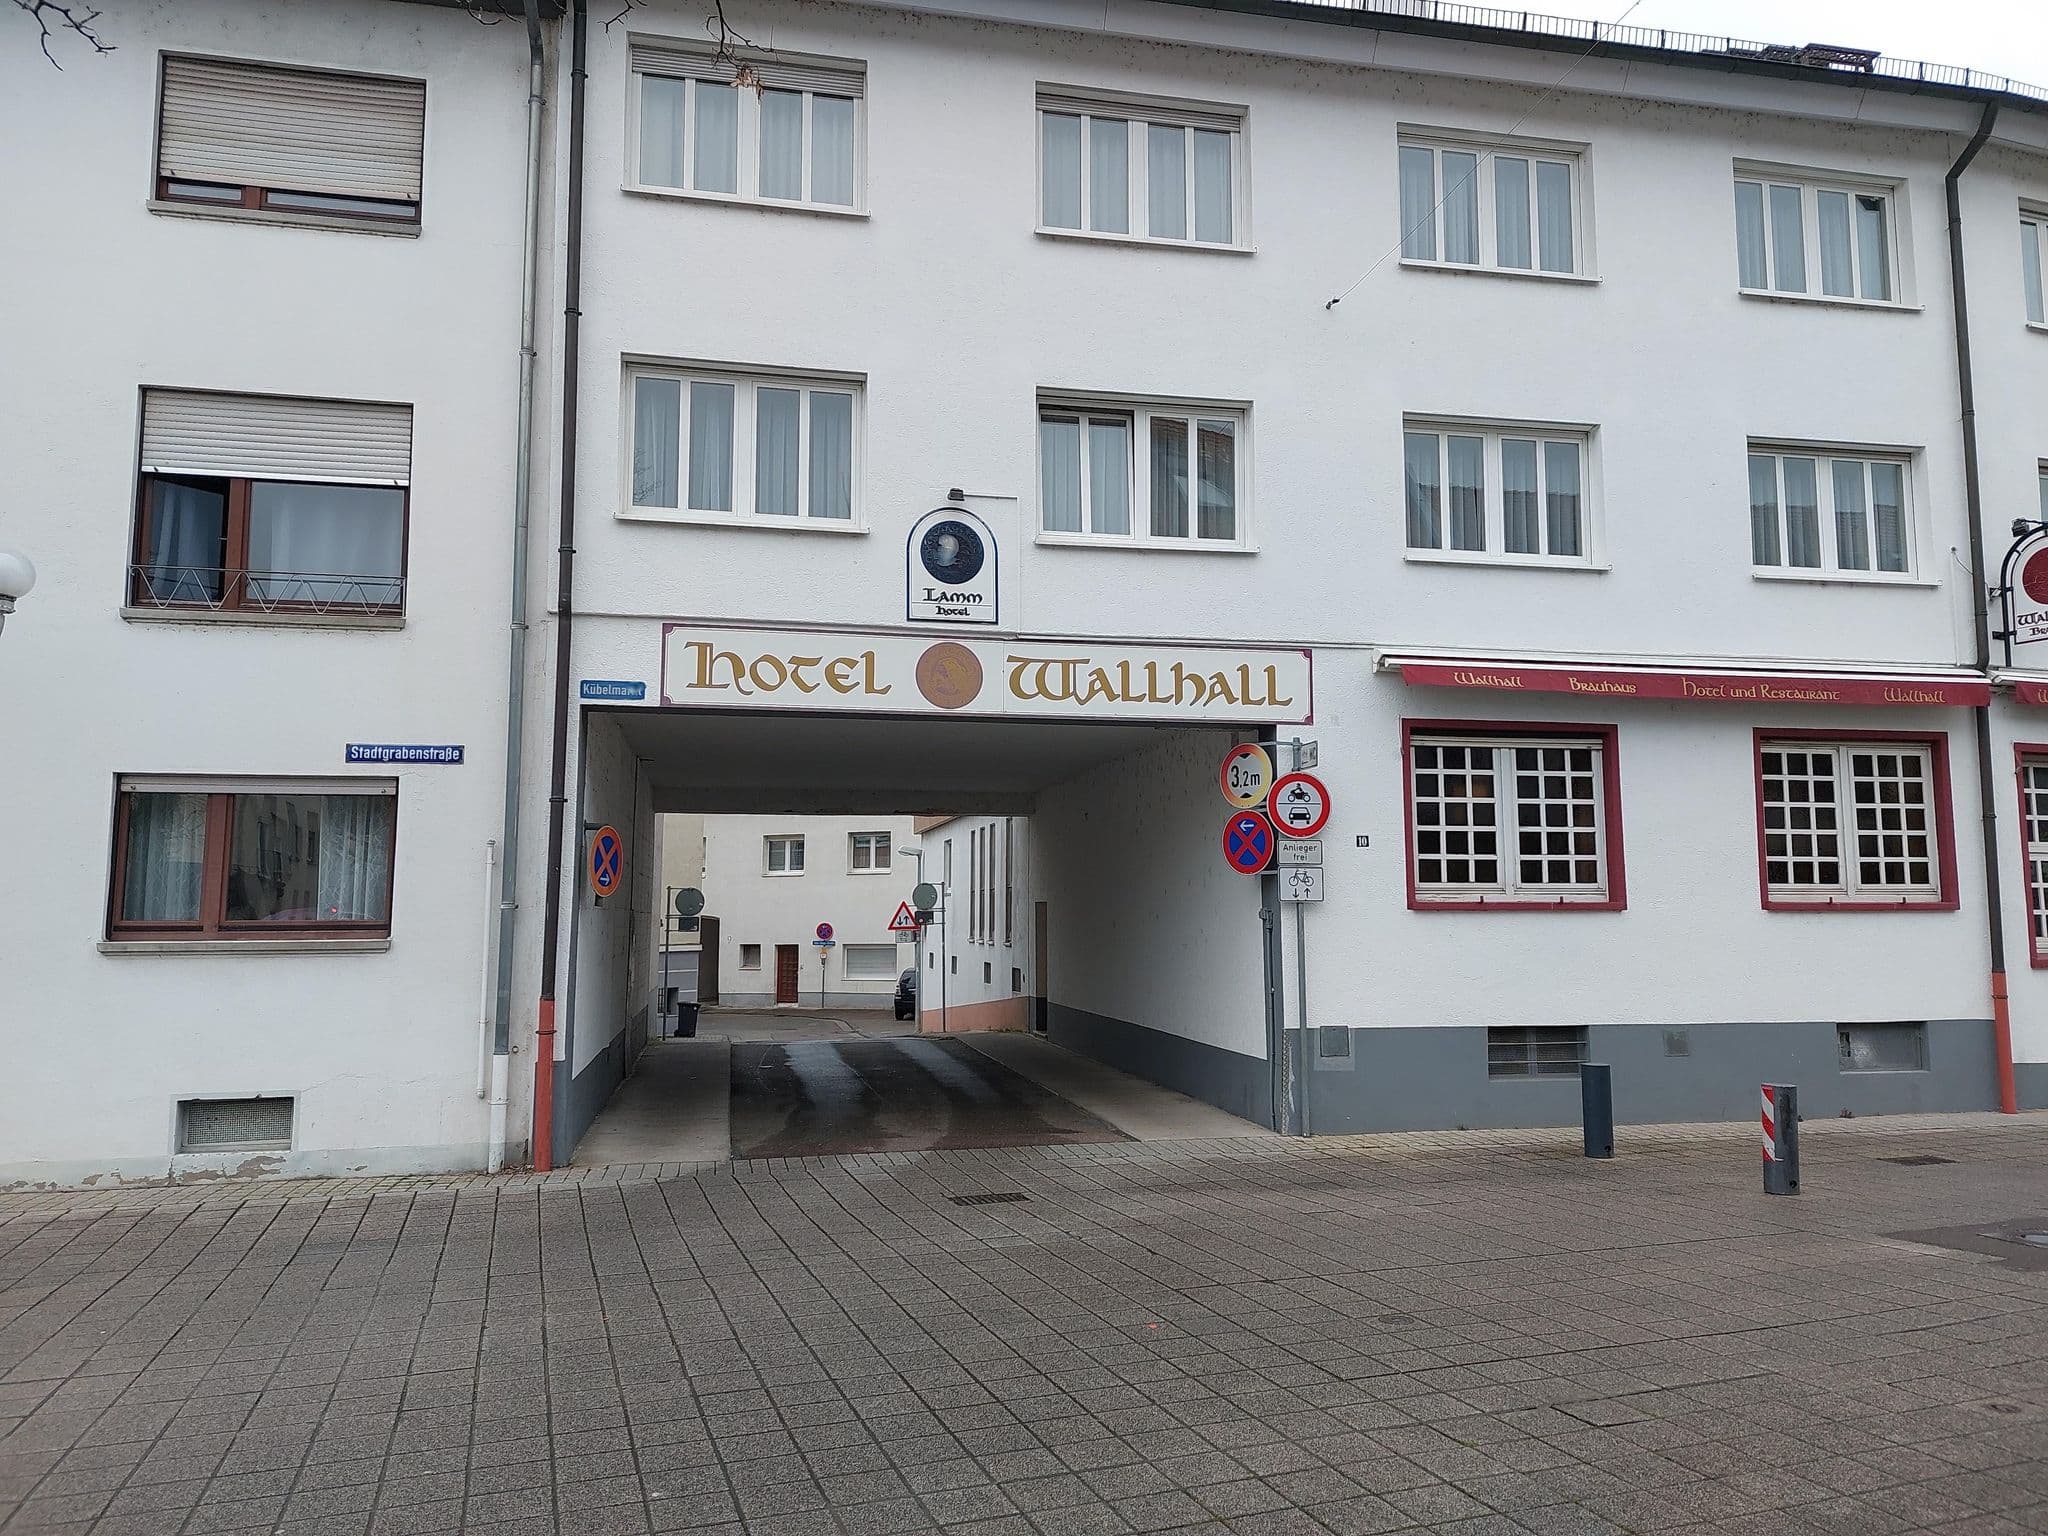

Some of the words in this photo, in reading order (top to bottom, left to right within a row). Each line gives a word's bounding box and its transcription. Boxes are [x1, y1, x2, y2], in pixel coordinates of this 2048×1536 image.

[923, 588, 983, 604] Lamm
[1454, 672, 1524, 688] Wallhall
[1568, 677, 1637, 693] Brauhaus
[583, 683, 642, 696] Kübelmart
[1681, 677, 1726, 697] Hotel
[1730, 686, 1756, 698] und
[1760, 684, 1840, 700] Restaurant
[1883, 687, 1946, 702] Wallhall
[351, 746, 460, 761] Stadtgrabenstraße
[1283, 844, 1317, 853] Anlieger
[1358, 836, 1367, 846] 10
